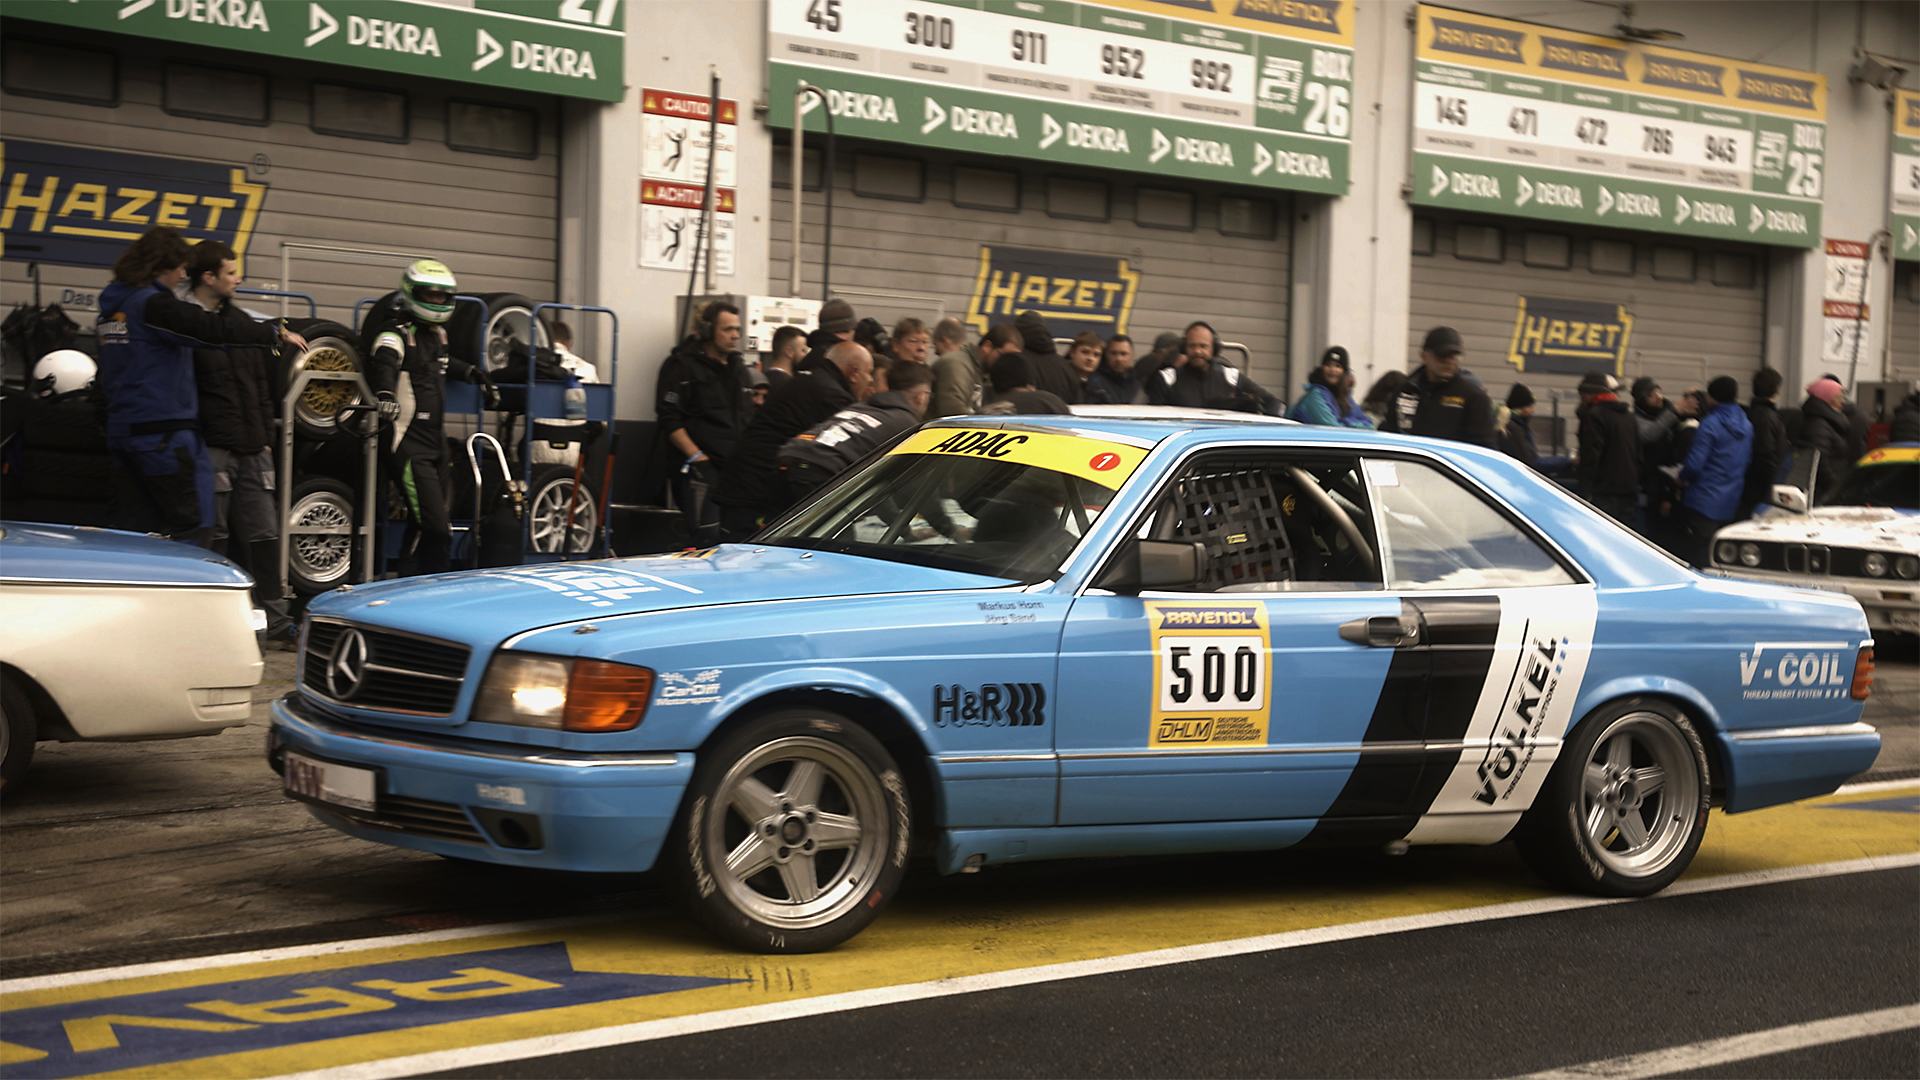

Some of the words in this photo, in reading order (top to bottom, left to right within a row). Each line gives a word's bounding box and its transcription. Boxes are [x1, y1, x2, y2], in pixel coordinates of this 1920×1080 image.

[166, 0, 270, 31] DEKRA
[905, 11, 955, 50] 300
[347, 15, 441, 57] DEKRA
[1012, 29, 1047, 65] 911
[1437, 27, 1519, 56] RAVENOL
[511, 40, 597, 80] DEKRA
[1101, 43, 1145, 80] 952
[1312, 48, 1351, 82] BOX
[1545, 45, 1622, 73] RAVENOL
[1191, 58, 1233, 94] 992
[1649, 61, 1719, 89] RAVENOL
[1743, 78, 1811, 103] RAVENOL
[661, 98, 713, 116] CAUTIO
[827, 89, 899, 123] DEKRA
[1304, 82, 1348, 137] 26
[1435, 95, 1468, 127] 145
[1508, 106, 1539, 137] 471
[952, 106, 1019, 139] DEKRA
[1066, 121, 1131, 153] DEKRA
[1575, 116, 1608, 147] 472
[1793, 123, 1825, 150] BOX
[1174, 136, 1235, 167] DEKRA
[1642, 125, 1674, 155] 786
[1704, 134, 1738, 164] 945
[1276, 150, 1333, 180] DEKRA
[1786, 150, 1823, 197] 25
[656, 186, 723, 206] ACHTUG
[1451, 171, 1502, 199] DEKRA
[1536, 181, 1584, 209] DEKRA
[0, 173, 237, 232] HAZET
[1616, 191, 1662, 218] DEKRA
[1692, 200, 1737, 227] DEKRA
[1765, 209, 1808, 234] DEKRA
[62, 289, 94, 306] Das
[984, 270, 1124, 315] HAZET
[1521, 315, 1621, 355] HAZET
[928, 431, 1029, 458] ADAC
[1096, 454, 1114, 469] 1
[1165, 611, 1253, 624] RAVENOL
[1170, 646, 1257, 703] 500
[933, 684, 1008, 727] H&R
[1532, 678, 1558, 739] SOLUTIONS
[1743, 690, 1771, 699] THREAD
[1771, 690, 1796, 699] INSERT
[1796, 689, 1823, 699] SYSTEM
[1160, 722, 1211, 738] DHLM
[1473, 636, 1558, 806] VÖLKEL
